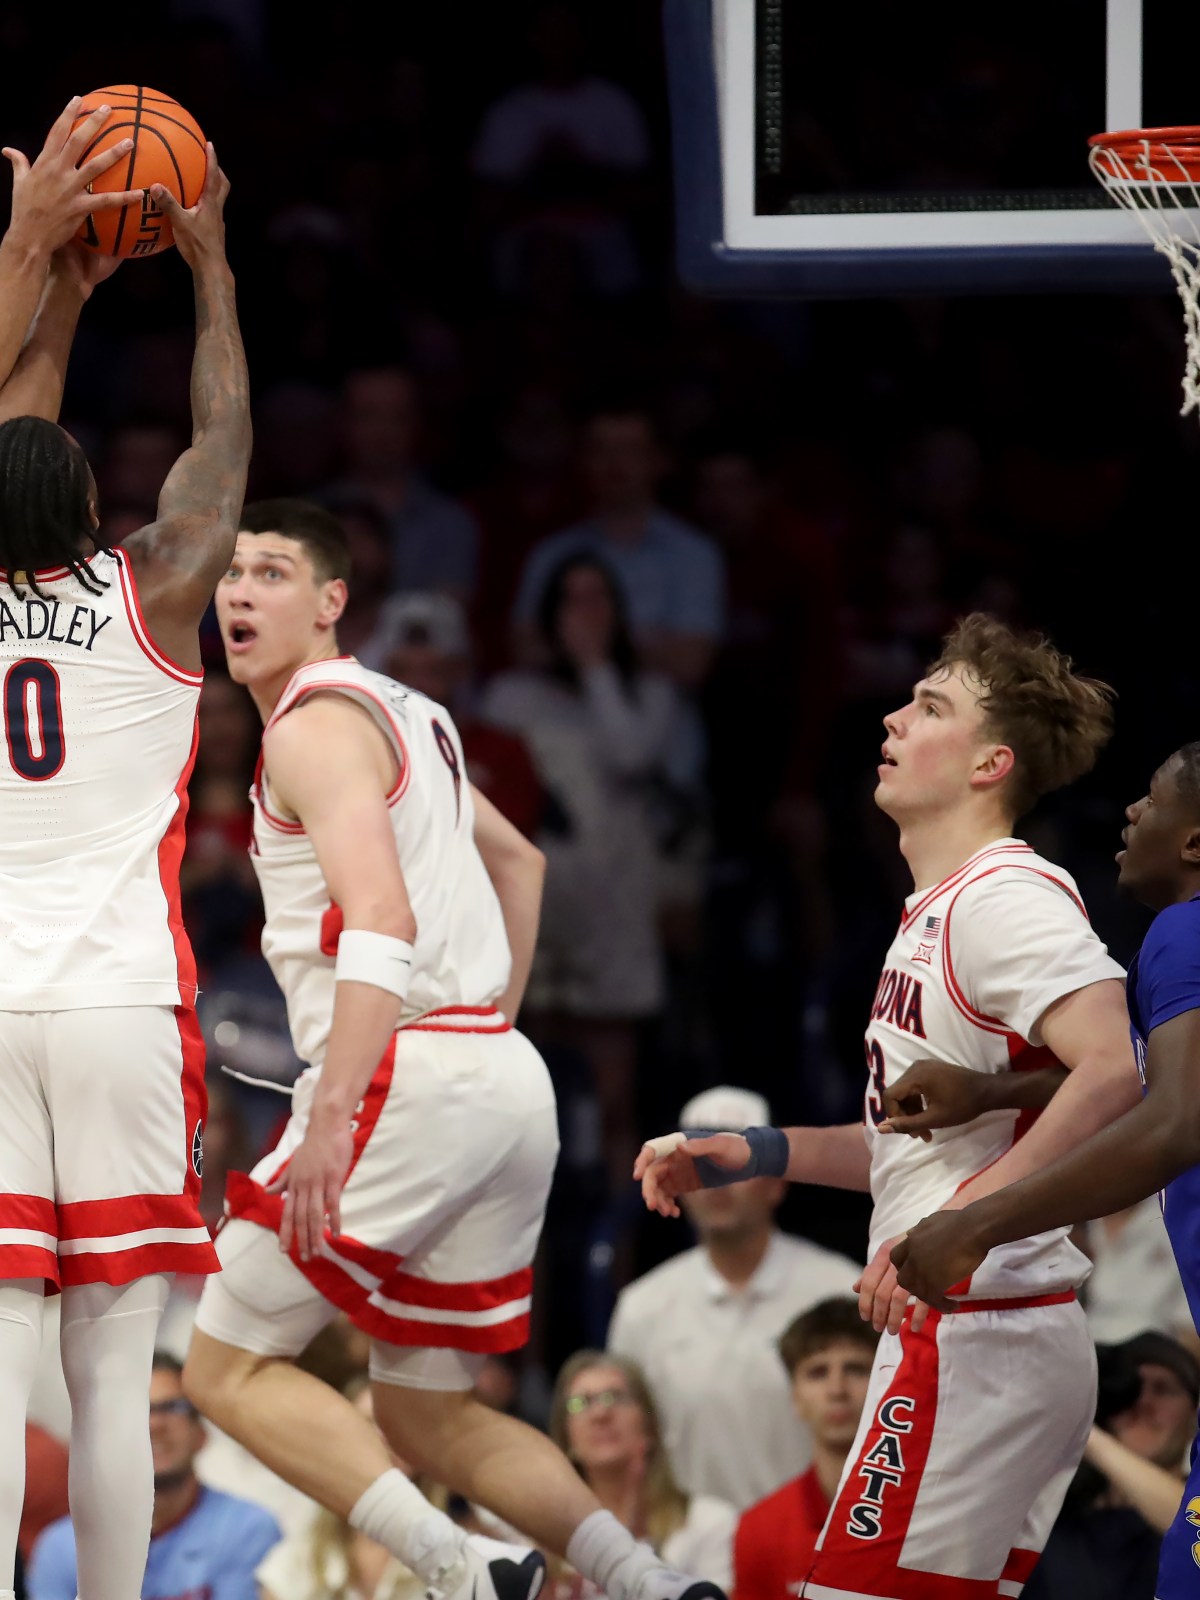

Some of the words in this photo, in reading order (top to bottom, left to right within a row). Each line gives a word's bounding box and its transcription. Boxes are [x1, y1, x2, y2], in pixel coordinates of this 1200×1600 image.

[3, 657, 66, 782] 0
[430, 716, 461, 832] 9
[846, 1395, 916, 1540] CATS
